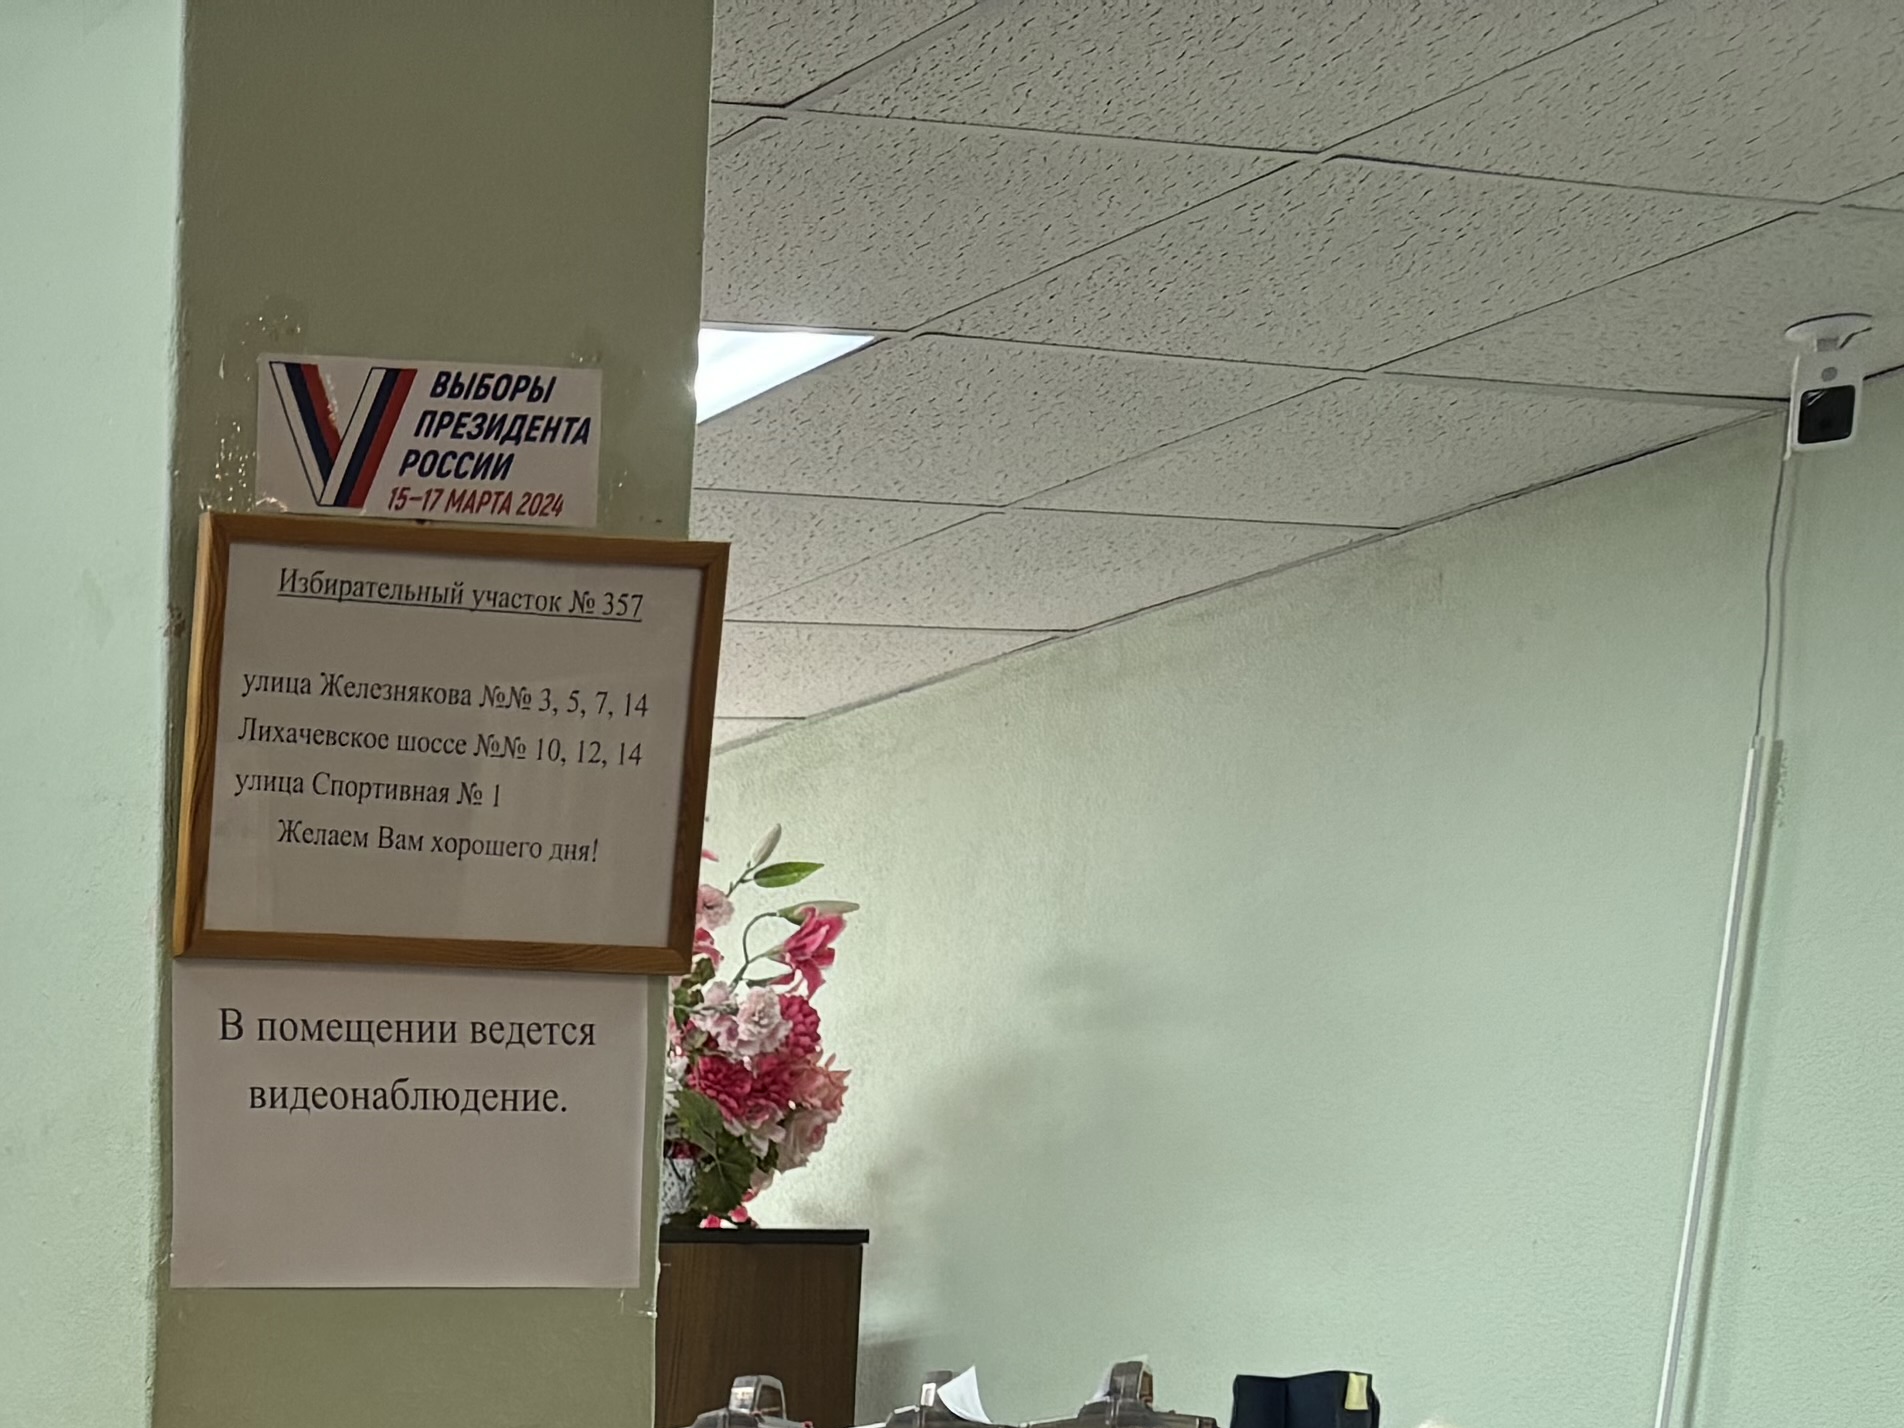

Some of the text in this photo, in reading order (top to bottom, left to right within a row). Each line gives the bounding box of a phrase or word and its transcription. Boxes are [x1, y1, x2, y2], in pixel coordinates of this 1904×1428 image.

[429, 370, 557, 403] ВЫБОРЫ
[414, 410, 592, 445] ПРЕЗИДЕНТА
[398, 449, 515, 481] РОССИИ
[445, 489, 511, 516] МАРТА
[516, 492, 564, 517] 2024
[277, 567, 643, 618] Избирательный участок № 357
[241, 672, 649, 718] улица Железнякова №№ 3, 5, 7, 14
[237, 717, 643, 768] Лихачевское шоссе №№ 10, 12, 14
[234, 772, 500, 808] улица Спортивная № 1
[276, 819, 599, 862] Желаем Вам хорошего дня!
[219, 1008, 597, 1049] В помещении ведется
[249, 1078, 568, 1117] видеонаблюдение.
